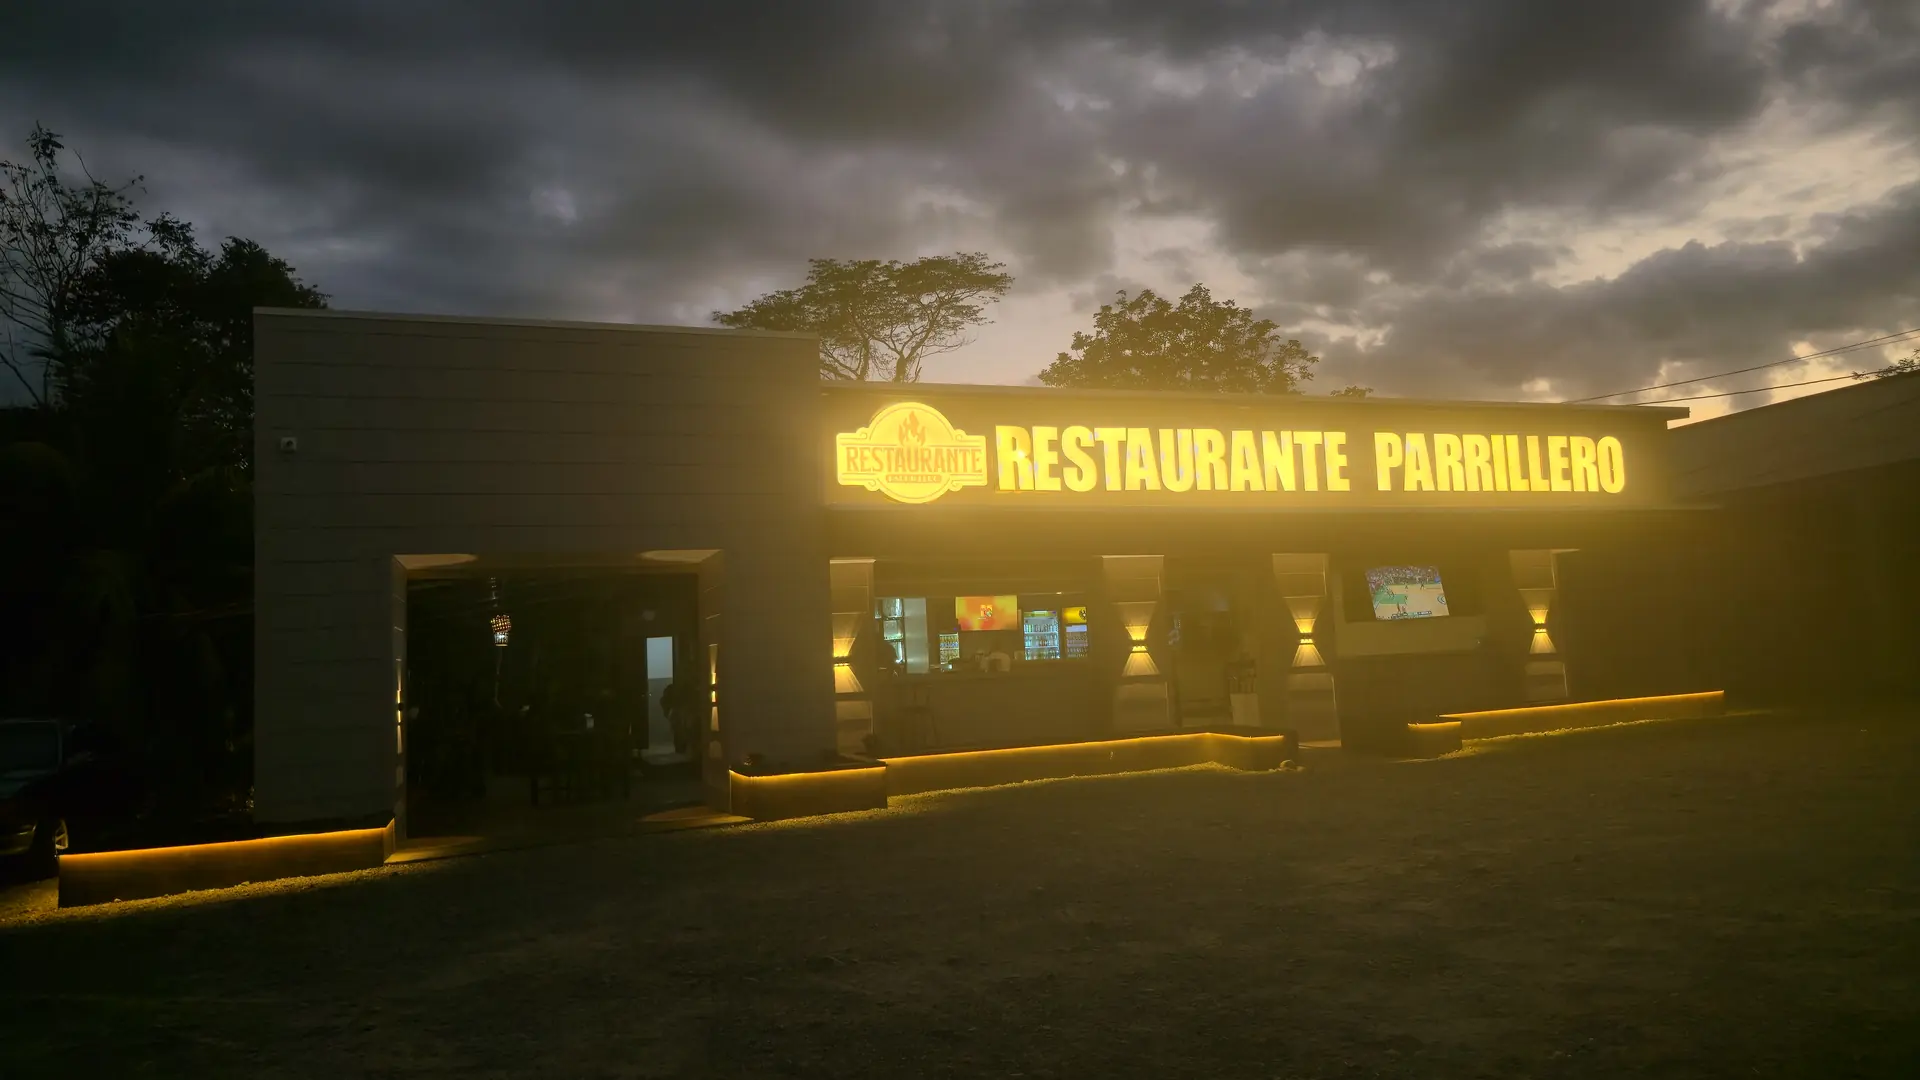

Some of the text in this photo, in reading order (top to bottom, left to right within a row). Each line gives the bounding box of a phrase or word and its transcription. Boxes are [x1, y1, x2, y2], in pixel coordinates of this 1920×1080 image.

[846, 446, 983, 473] RESTAURANTE
[996, 425, 1625, 494] RESTAURANTE PARRILLERO
